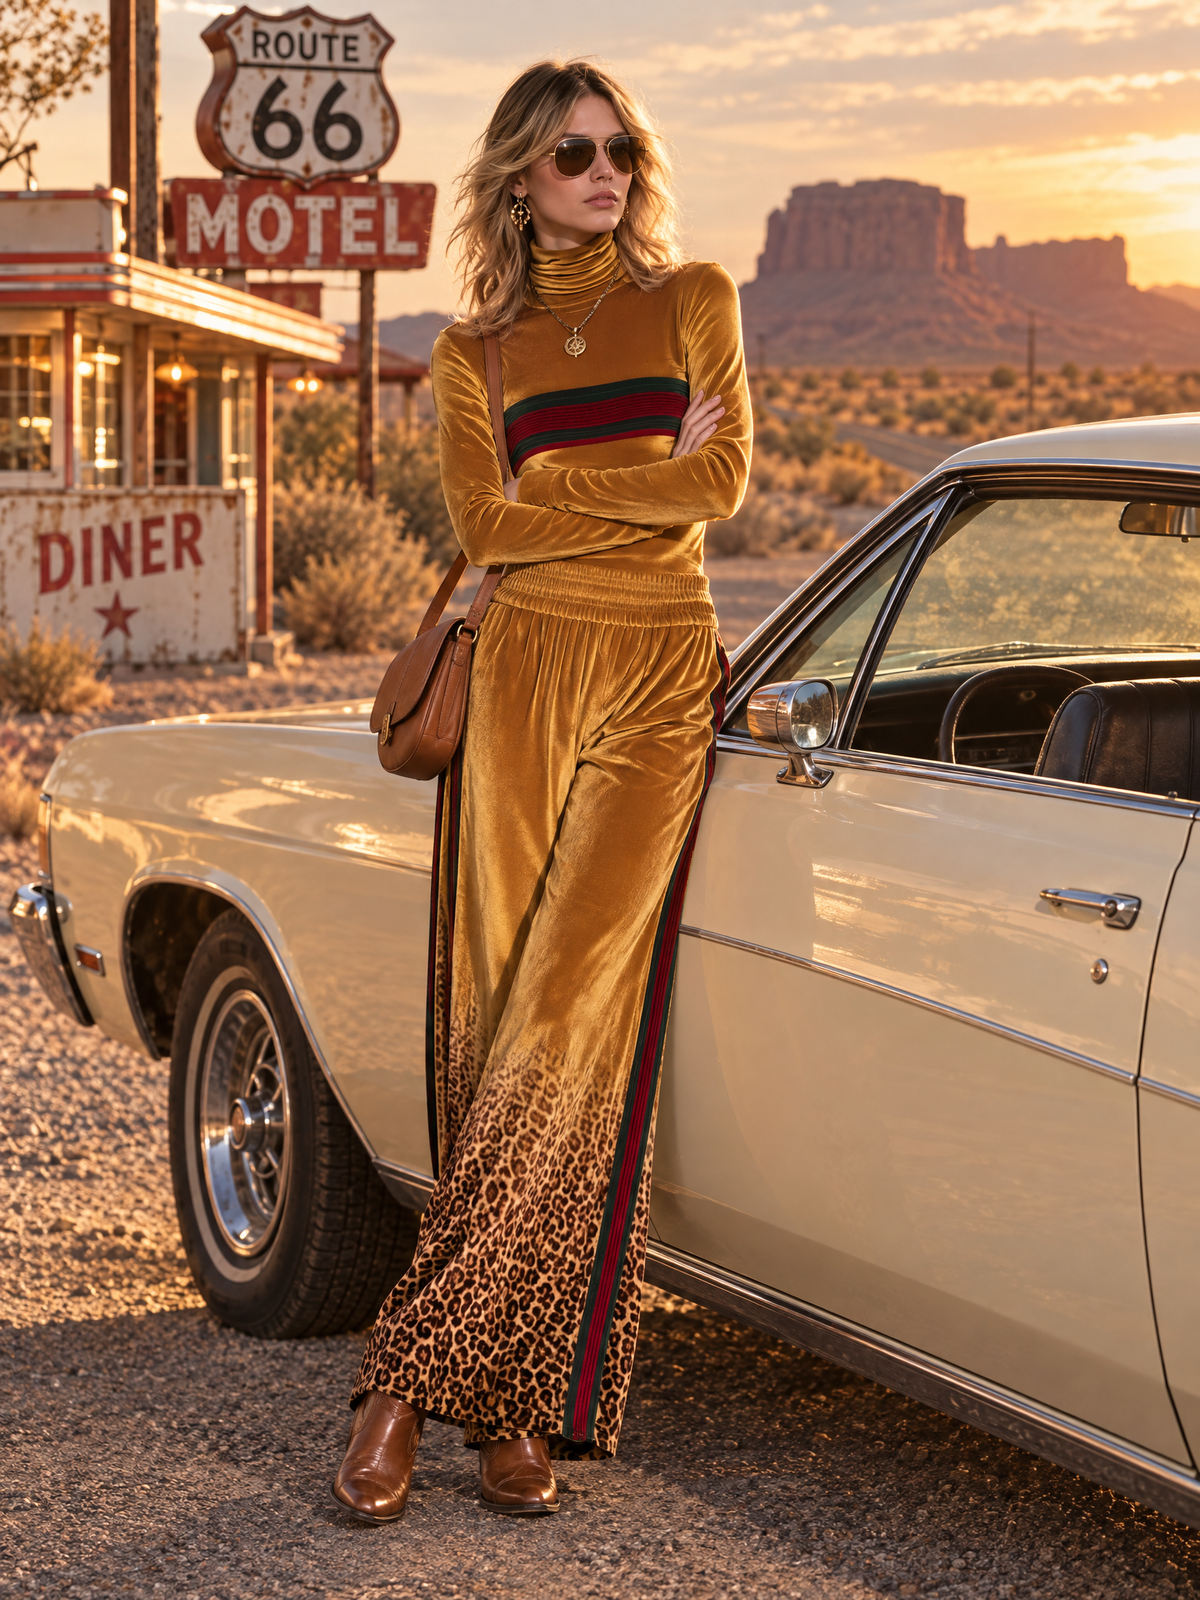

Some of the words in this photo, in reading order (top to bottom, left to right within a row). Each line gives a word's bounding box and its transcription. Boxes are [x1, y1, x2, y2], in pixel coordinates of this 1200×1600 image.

[252, 30, 360, 63] ROUTE
[252, 76, 363, 162] 66
[186, 193, 419, 255] MOTEL
[38, 511, 204, 595] DINER
